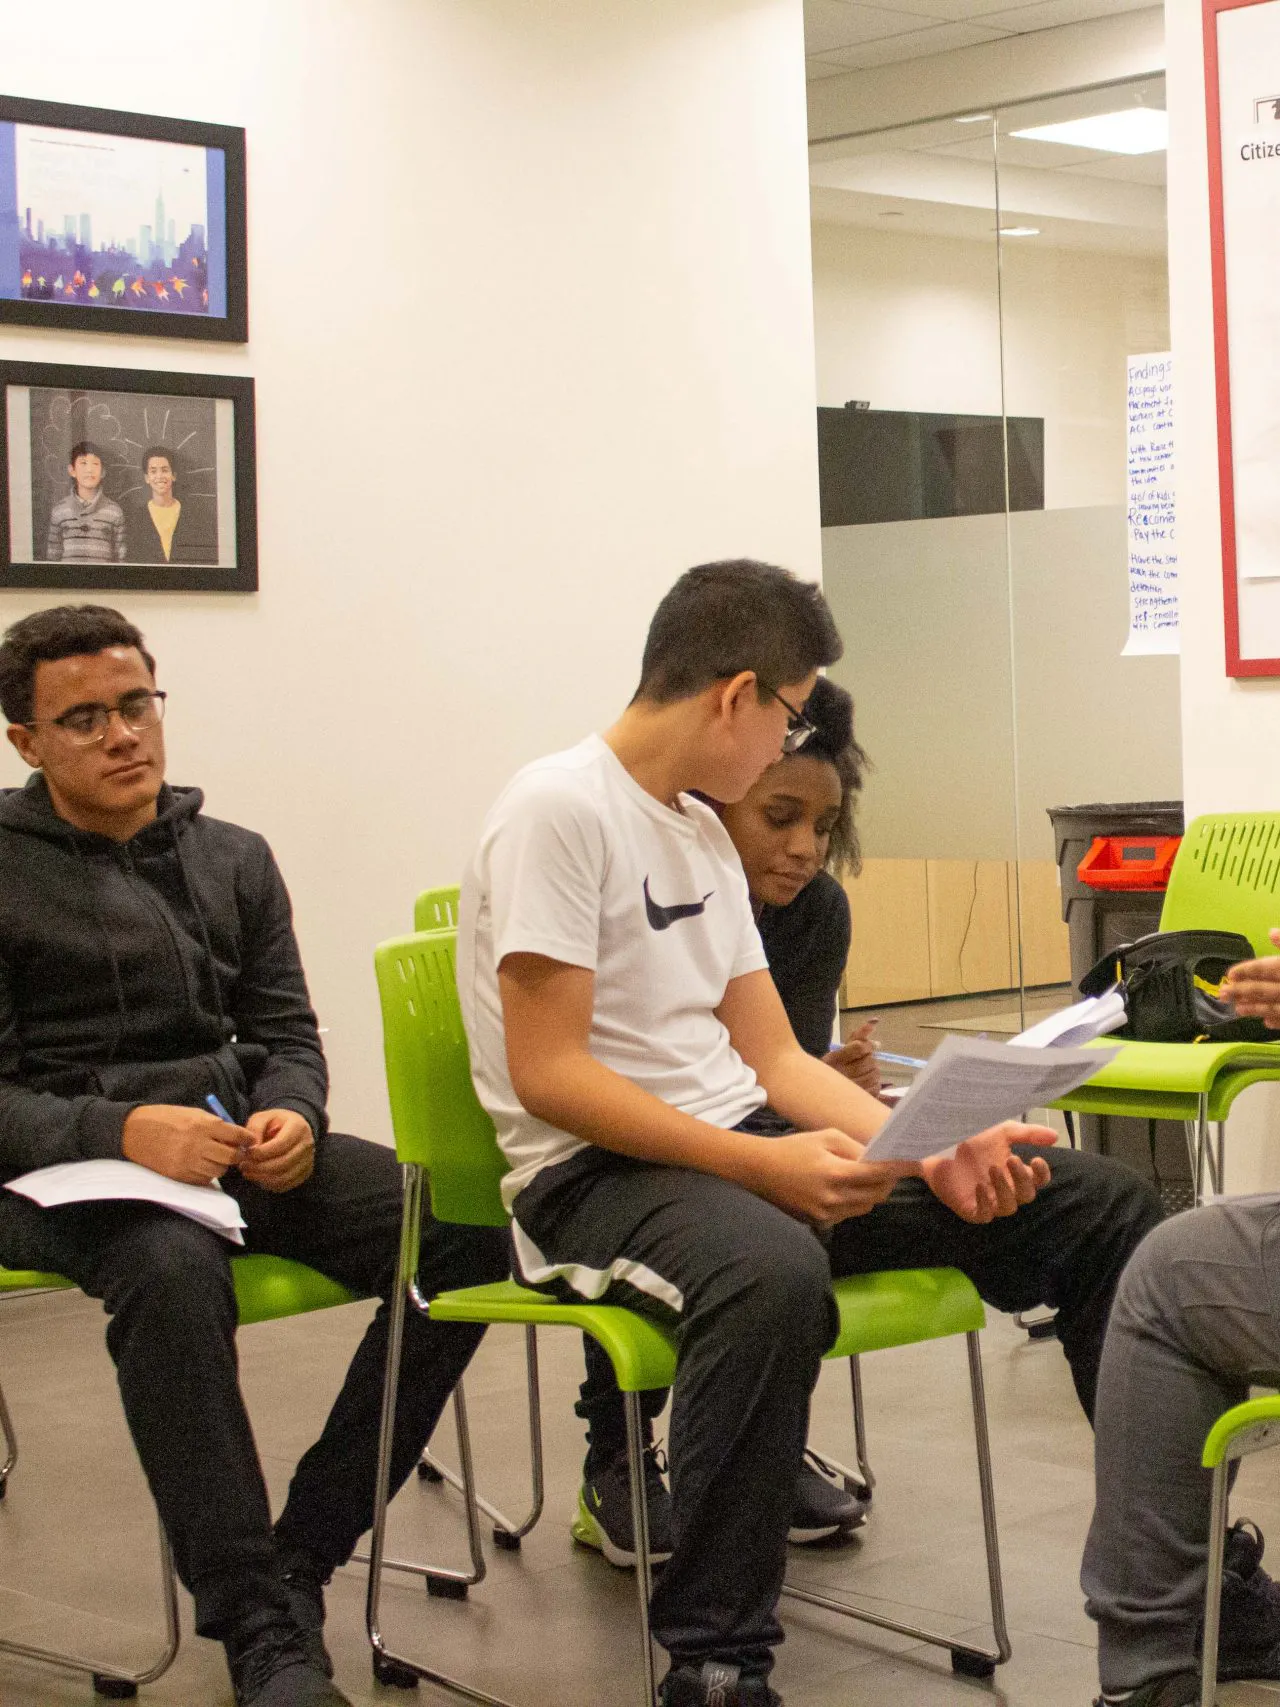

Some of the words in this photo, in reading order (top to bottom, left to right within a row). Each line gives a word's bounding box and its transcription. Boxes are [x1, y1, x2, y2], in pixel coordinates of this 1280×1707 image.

[1129, 361, 1172, 381] Findings
[1134, 528, 1148, 544] Pay
[1151, 528, 1165, 538] the
